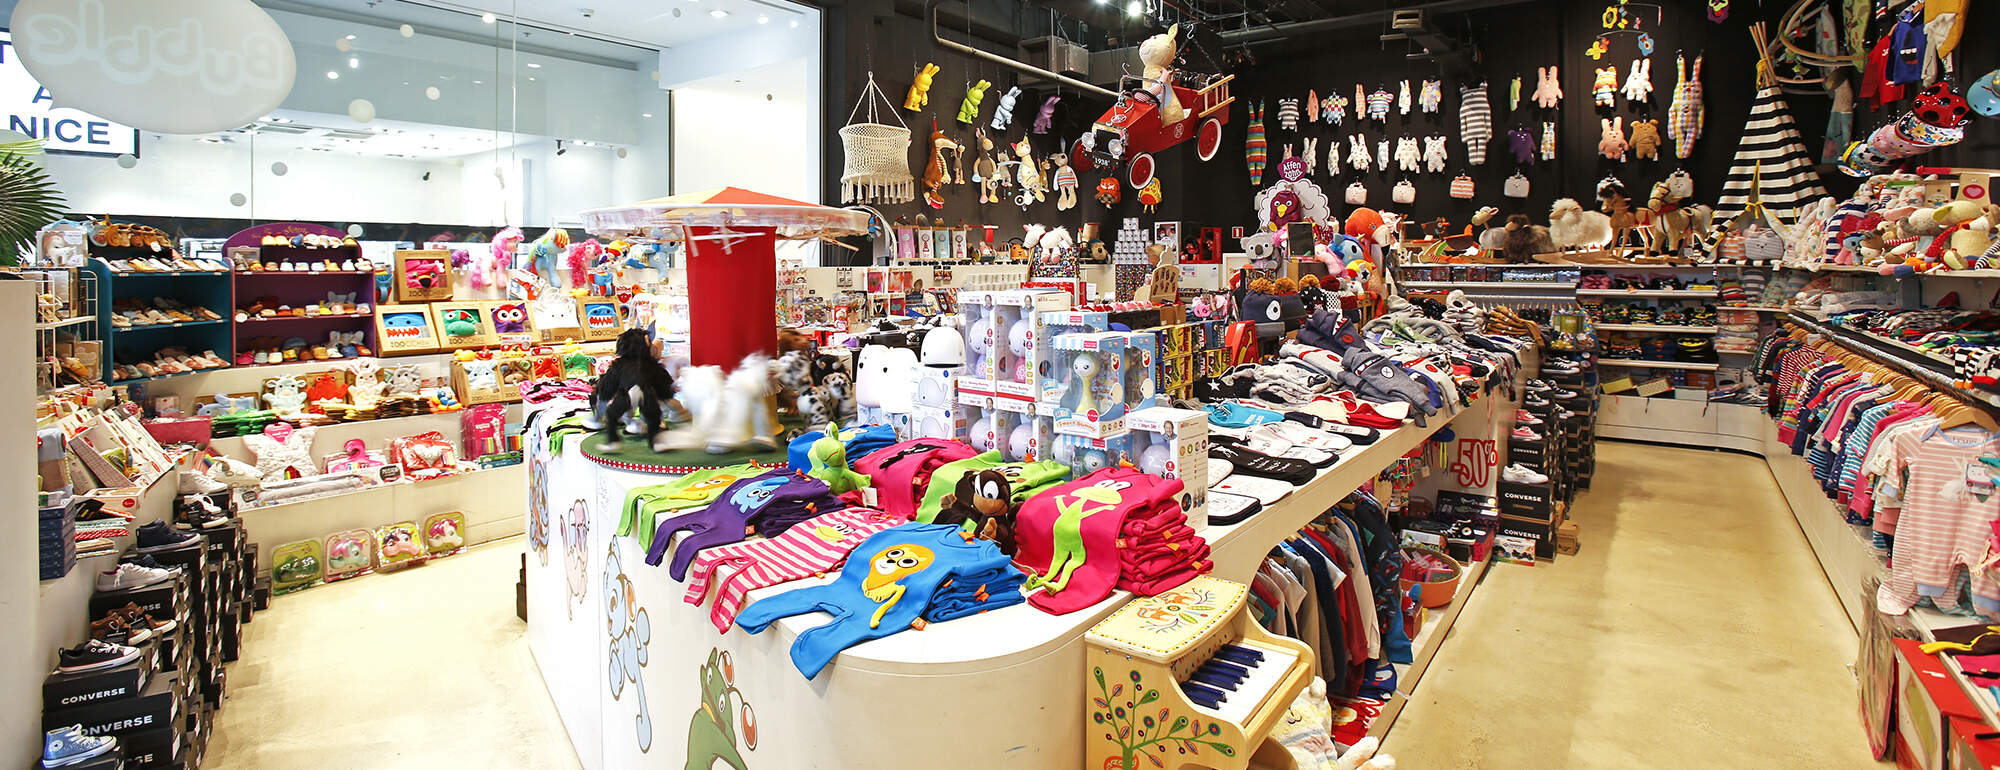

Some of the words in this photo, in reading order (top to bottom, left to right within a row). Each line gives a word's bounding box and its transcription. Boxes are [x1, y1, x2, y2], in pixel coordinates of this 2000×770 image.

[9, 114, 110, 145] NICE
[1451, 438, 1498, 488] -50%
[1504, 492, 1542, 502] CONVERSE
[1504, 529, 1541, 539] CONVERSE
[61, 687, 126, 705] CONVERSE
[82, 714, 153, 736] ONVERSE
